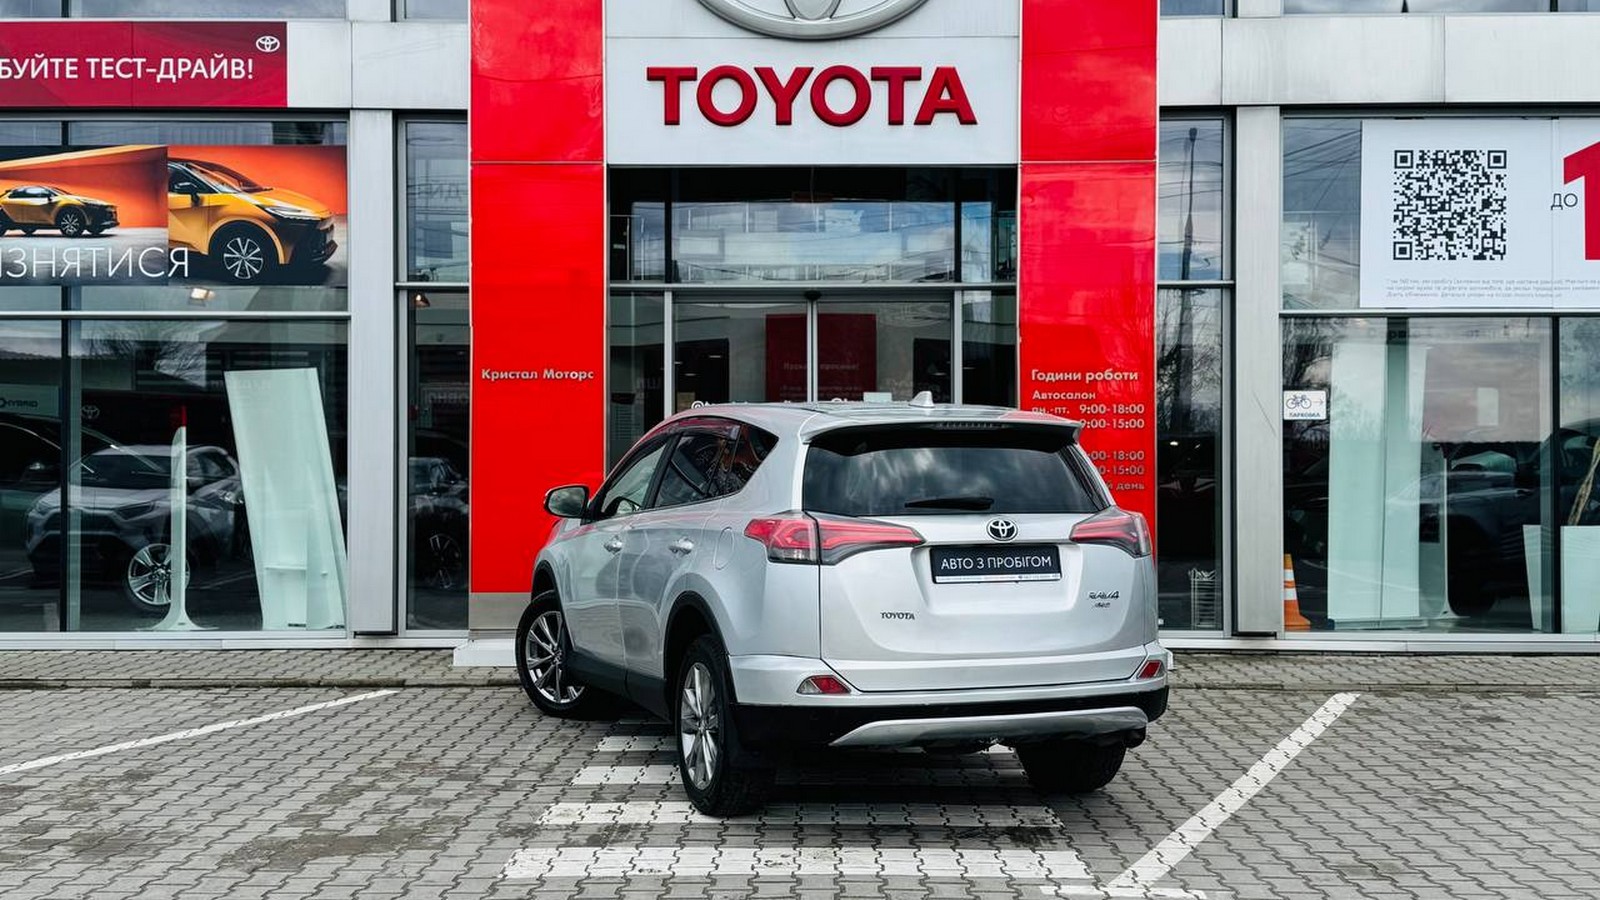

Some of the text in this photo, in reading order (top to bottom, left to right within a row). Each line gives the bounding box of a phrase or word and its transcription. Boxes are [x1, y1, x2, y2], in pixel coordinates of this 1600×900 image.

[0, 53, 253, 82] БУЙТЕ ТЕСТ-ДРАЙВ!
[647, 65, 978, 127] TOYOTA
[481, 368, 594, 381] Кристал Моторс
[1031, 368, 1138, 383] Години роботи
[1032, 390, 1096, 400] Автосалон
[1115, 482, 1145, 491] день
[940, 557, 974, 570] АВТО
[987, 555, 1052, 569] ПРОБІГОМ
[880, 611, 916, 620] TOYOTA
